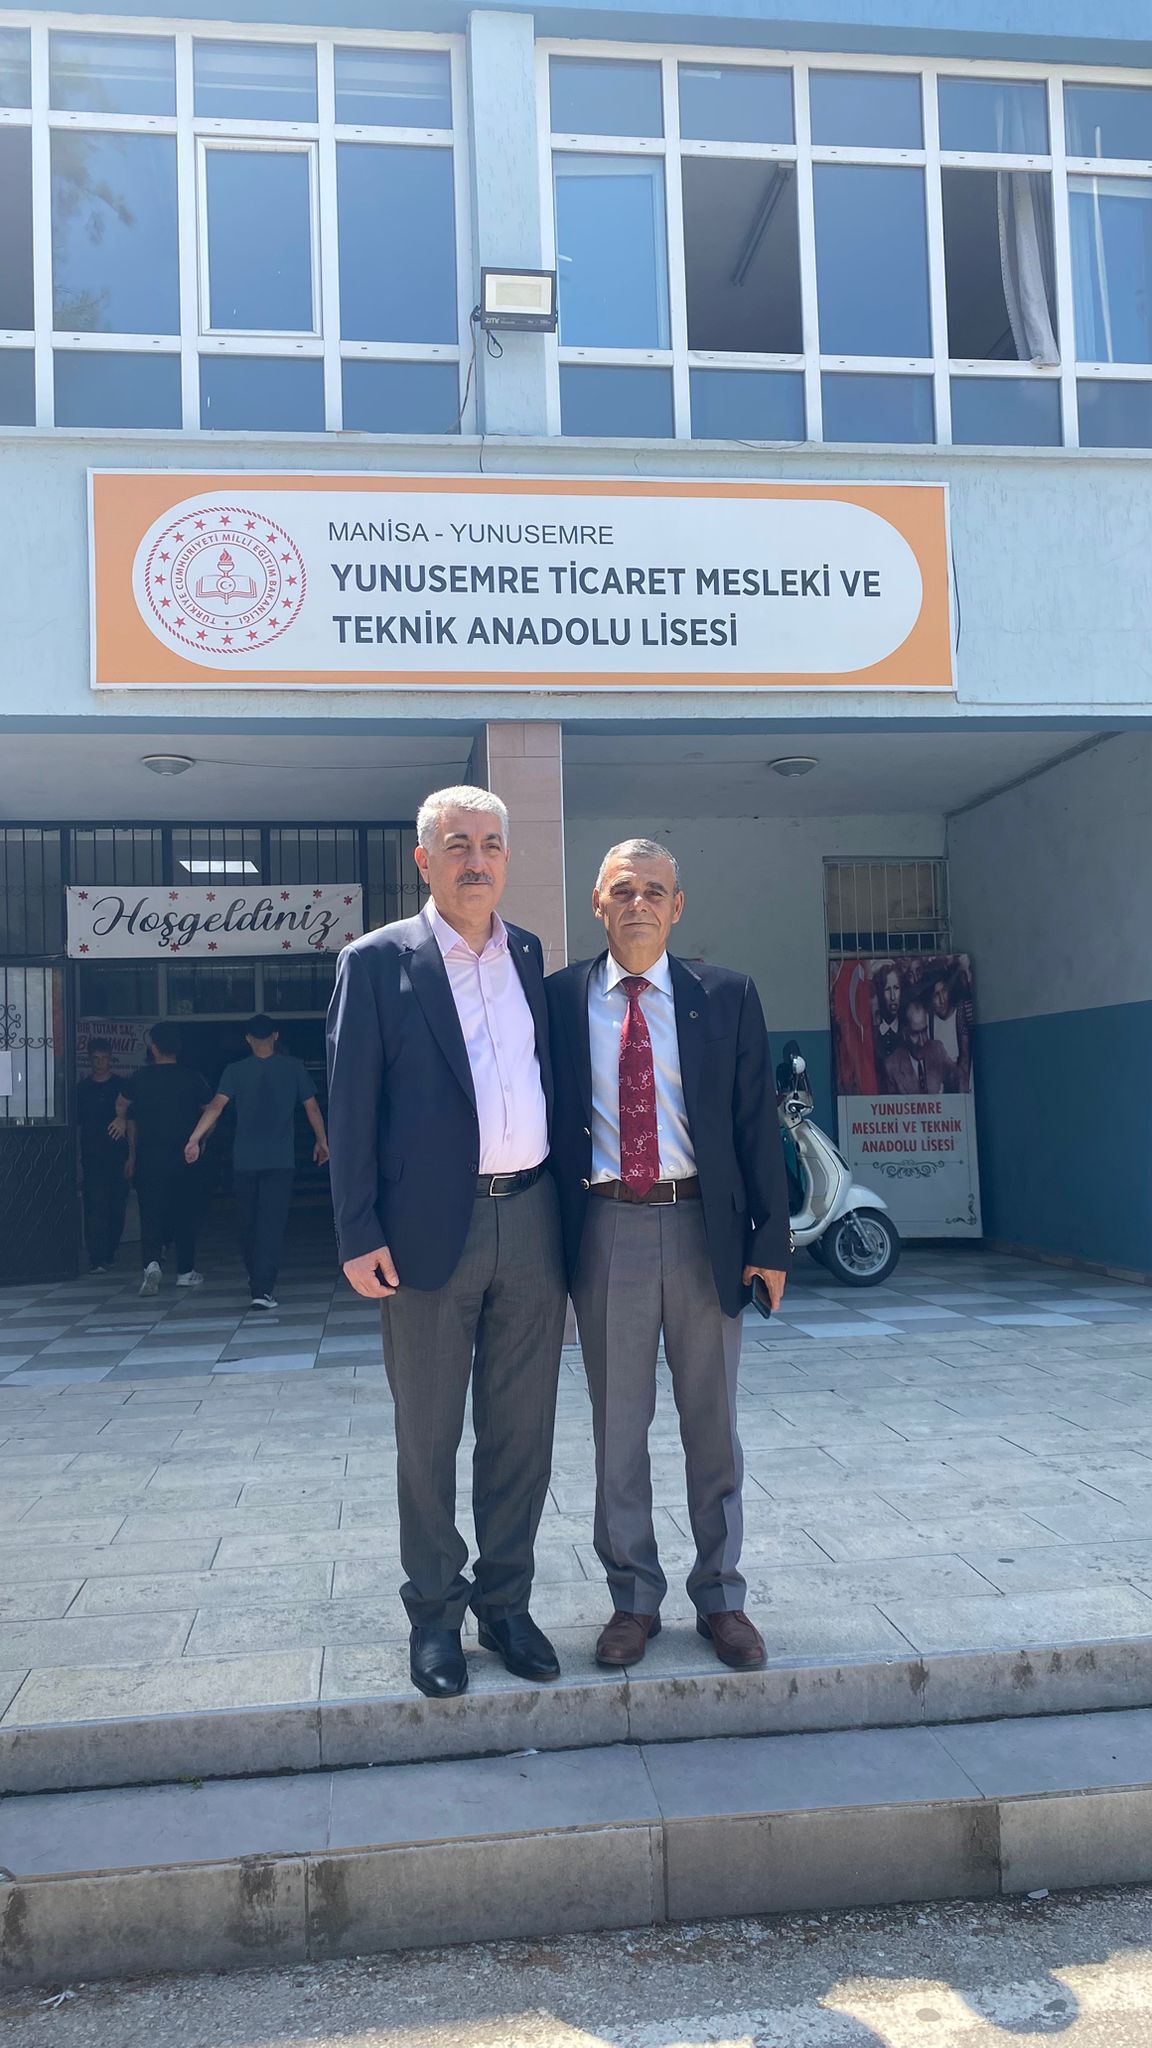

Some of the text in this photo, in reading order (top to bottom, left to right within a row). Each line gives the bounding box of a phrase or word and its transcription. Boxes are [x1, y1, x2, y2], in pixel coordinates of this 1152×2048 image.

[221, 533, 252, 547] MİLLİ
[329, 519, 428, 542] MANİSA
[450, 524, 614, 545] YUNUSEMRE
[175, 532, 219, 590] CUMHURİYETİ
[252, 545, 277, 578] EĞİTİM
[331, 561, 881, 597] YUNUSEMRE TİCARET MESLEKİ VE
[238, 580, 277, 625] BAKANLIĞI
[332, 610, 737, 646] TEKNİK ANADOLU LİSESİ
[92, 896, 339, 947] Hoşgeldiniz
[871, 1102, 942, 1115] YUNUSEMRE
[852, 1117, 962, 1134] MESLEKİ VE TEKNİK
[862, 1136, 954, 1152] ANADOLU LİSESİ
